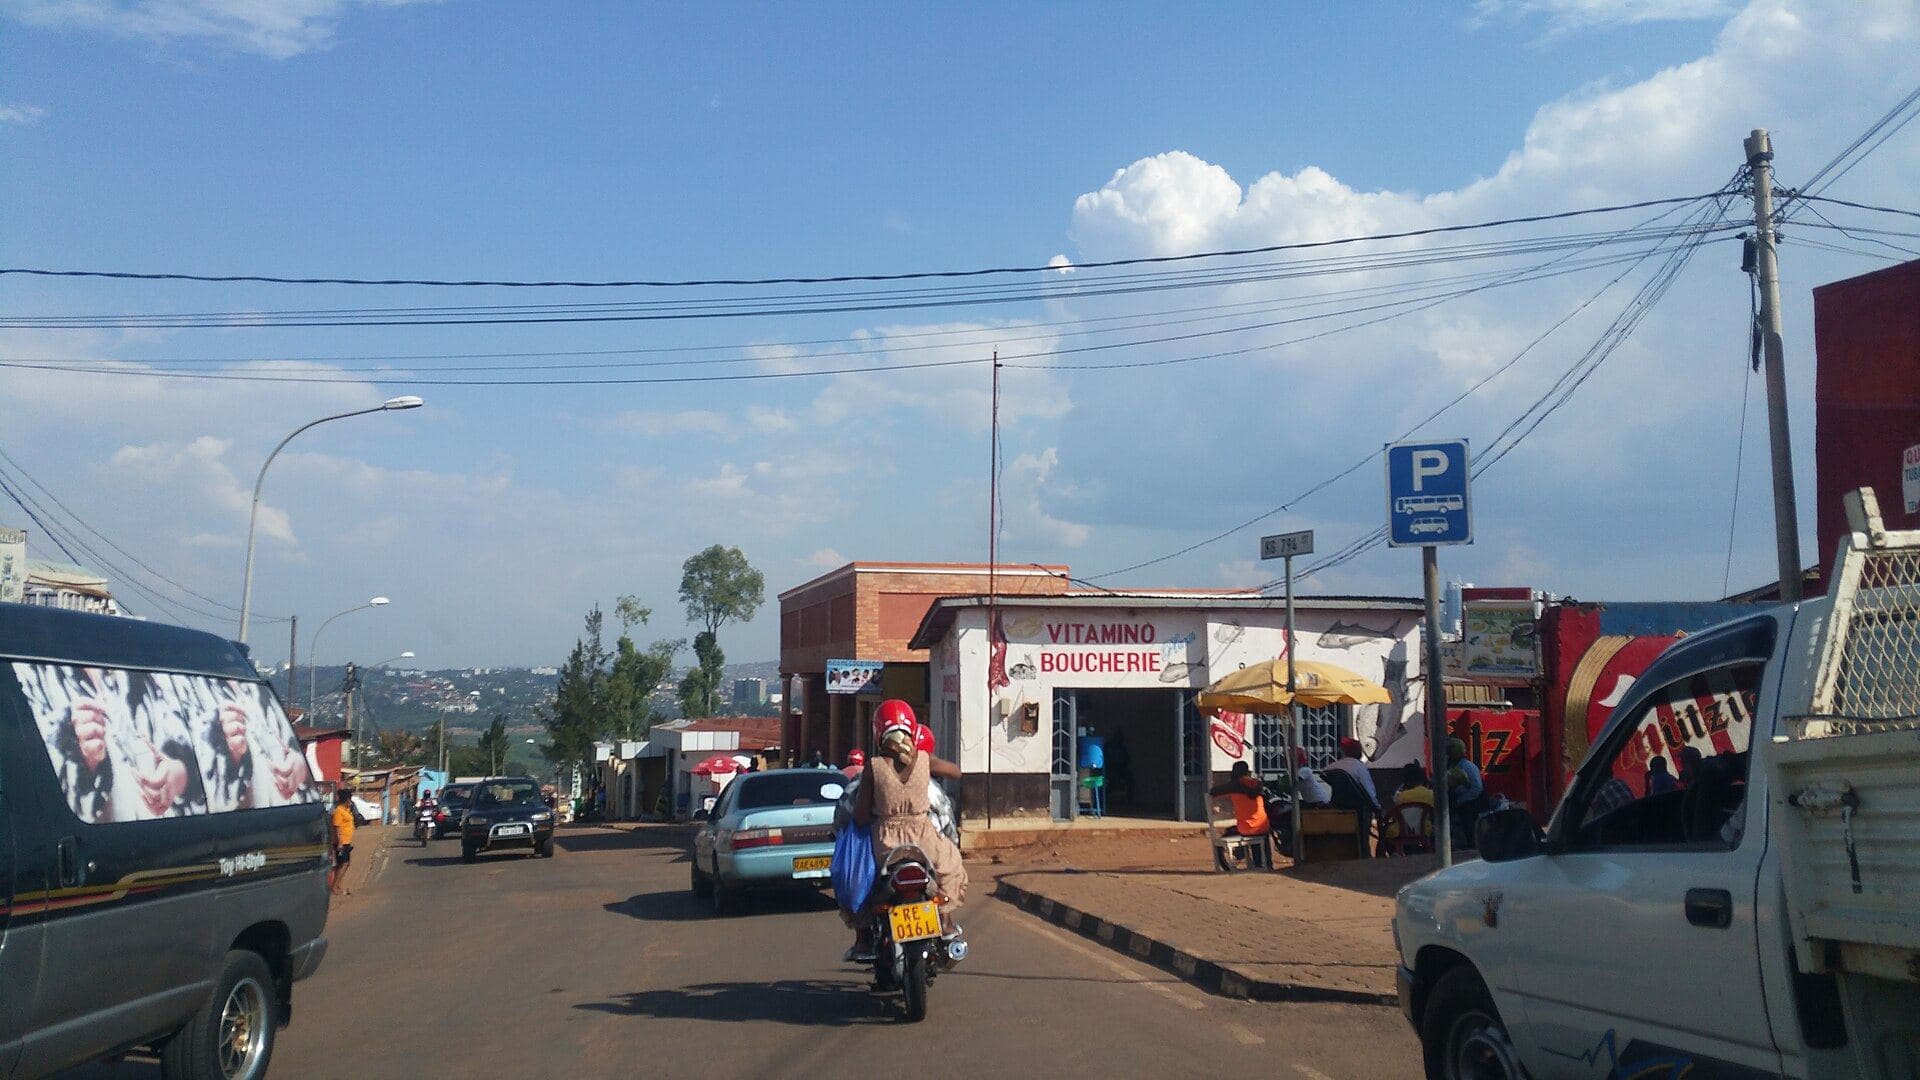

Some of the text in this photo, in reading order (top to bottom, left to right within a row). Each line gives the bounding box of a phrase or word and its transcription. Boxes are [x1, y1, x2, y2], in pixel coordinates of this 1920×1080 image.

[1412, 449, 1449, 491] P
[1047, 623, 1155, 644] VITAMINO
[1041, 652, 1161, 672] BOUCHERIE
[903, 906, 920, 921] RE
